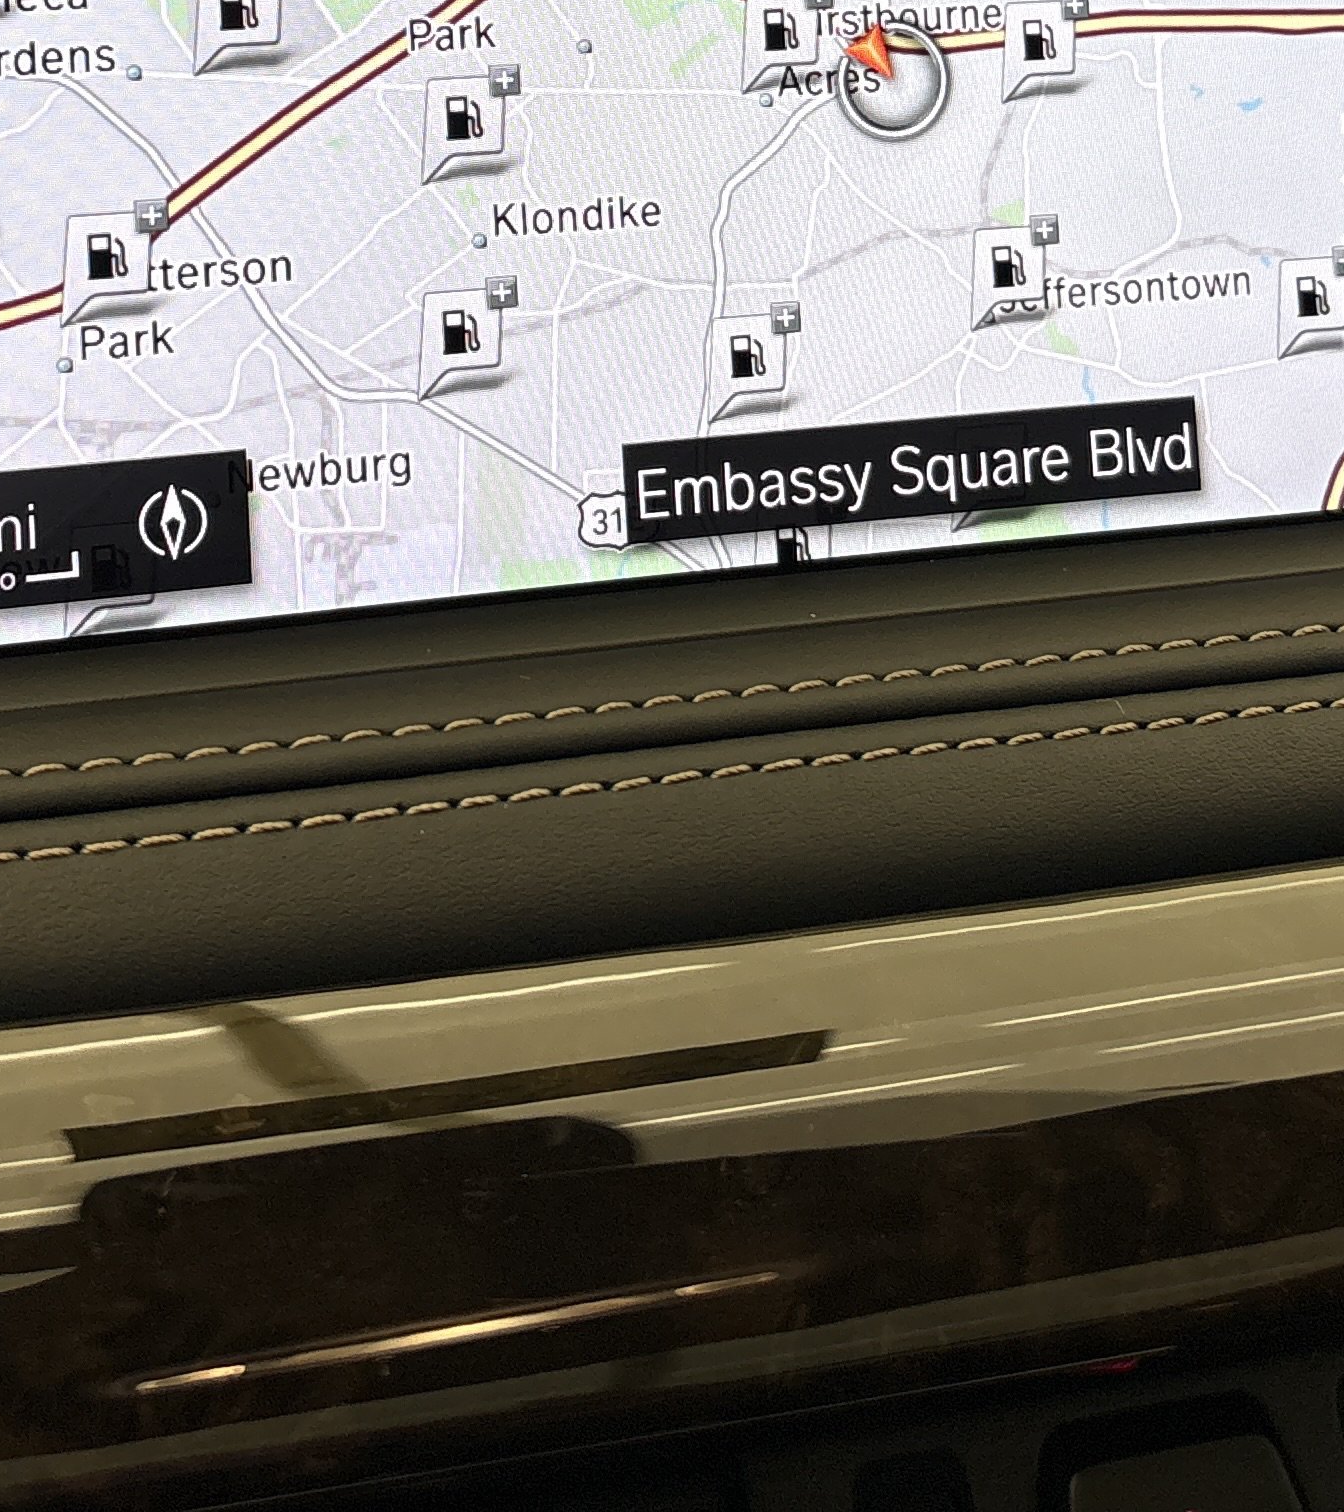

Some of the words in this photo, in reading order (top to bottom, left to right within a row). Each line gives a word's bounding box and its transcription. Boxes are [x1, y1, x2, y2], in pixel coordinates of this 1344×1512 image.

[409, 16, 496, 51] Park
[778, 65, 881, 96] Acres
[492, 197, 661, 237] Klondike
[80, 320, 174, 361] Park
[637, 459, 872, 521] Embassy
[890, 443, 1070, 502] Square
[1089, 421, 1193, 478] Blvd
[592, 506, 624, 536] 31
